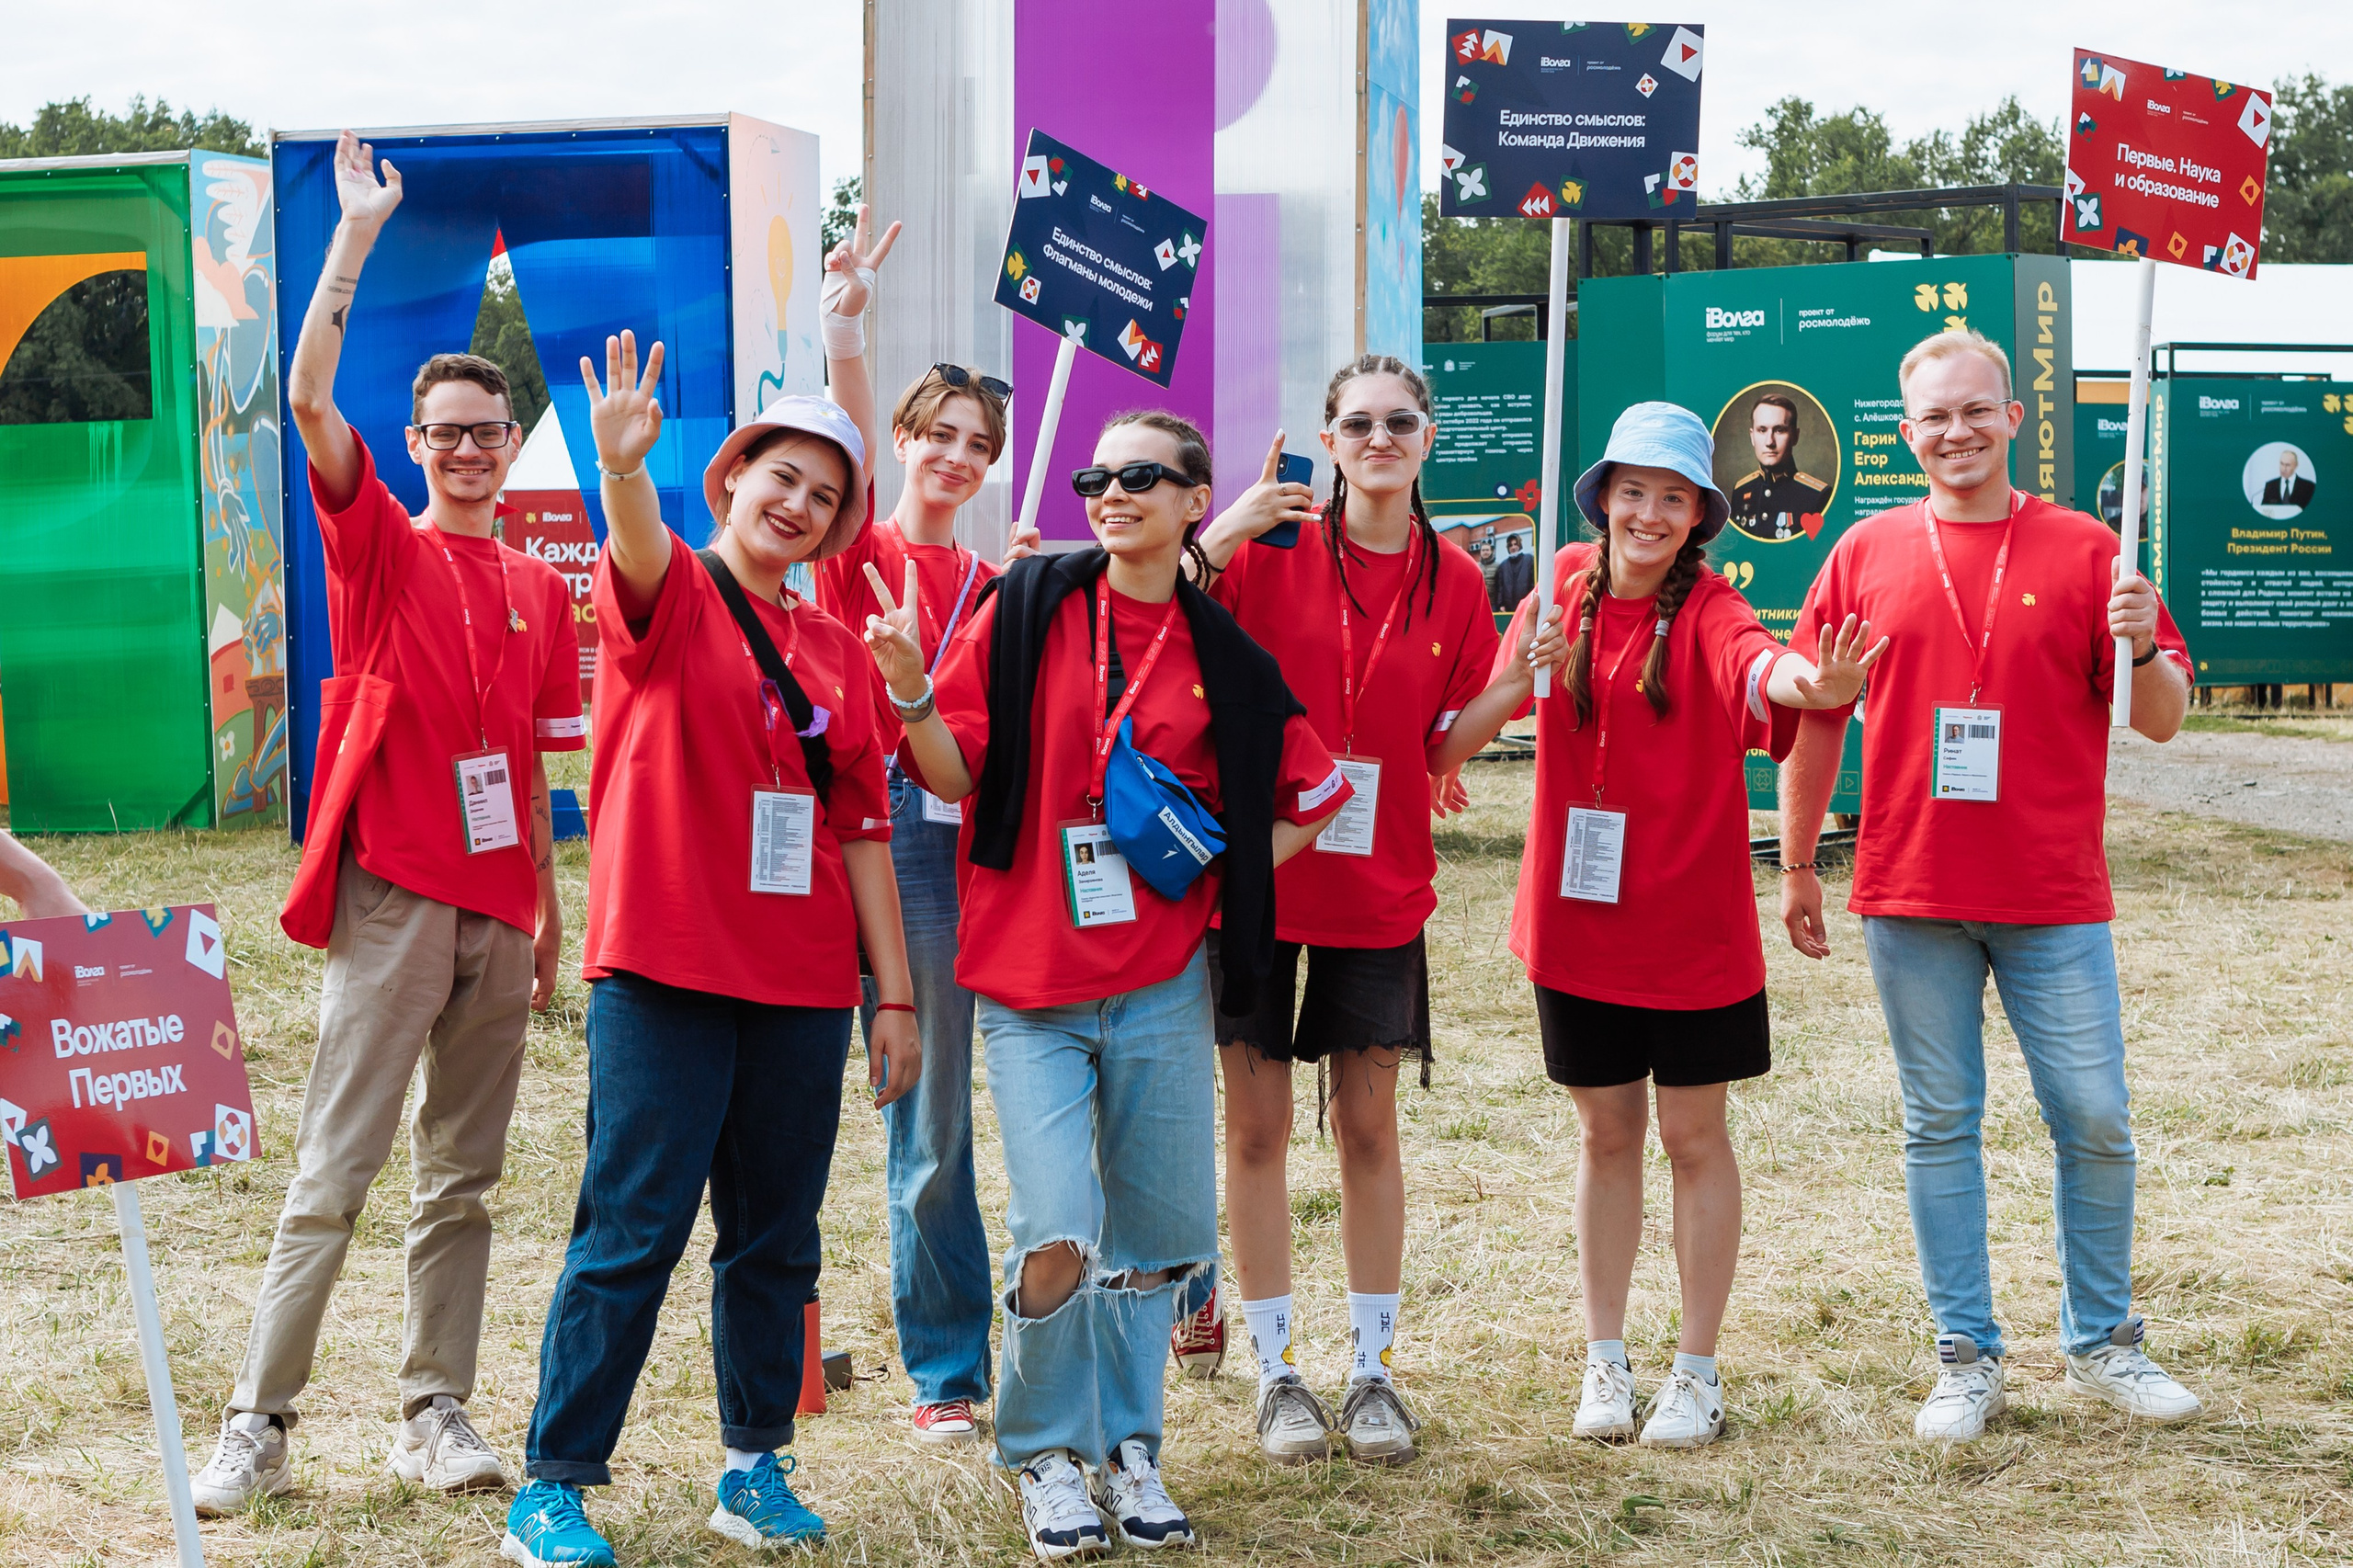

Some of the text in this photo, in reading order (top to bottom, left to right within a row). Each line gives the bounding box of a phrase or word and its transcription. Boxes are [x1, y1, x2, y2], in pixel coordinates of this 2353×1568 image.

[1500, 109, 1646, 127] Единство смыслов:
[1498, 131, 1645, 149] Команда Движения
[2117, 142, 2222, 184] Первые. Наука
[2115, 173, 2220, 209] и образование
[1051, 226, 1154, 291] Единство смыслов:
[1042, 244, 1154, 312] Флагманы молодежи
[1705, 307, 1765, 328] iВолга
[1799, 308, 1824, 317] проект
[1799, 315, 1871, 332] росмолодёжь
[1854, 399, 1904, 409] Нижегородс
[1854, 412, 1904, 423] с. Алёшково
[1854, 431, 1897, 449] Гарин
[1854, 451, 1888, 469] Егор
[1854, 472, 1930, 488] Александр
[1854, 495, 1924, 506] Награждён государ
[2153, 394, 2165, 596] тоМеняютМир
[2231, 528, 2328, 540] Владимир Путин,
[525, 537, 599, 566] Кажд
[2227, 542, 2332, 554] Президент России
[2333, 579, 2353, 587] котор
[1753, 608, 1802, 620] итники
[1163, 812, 1210, 862] Алдынгылар
[51, 1014, 184, 1059] Вожатые
[69, 1063, 188, 1111] Первых
